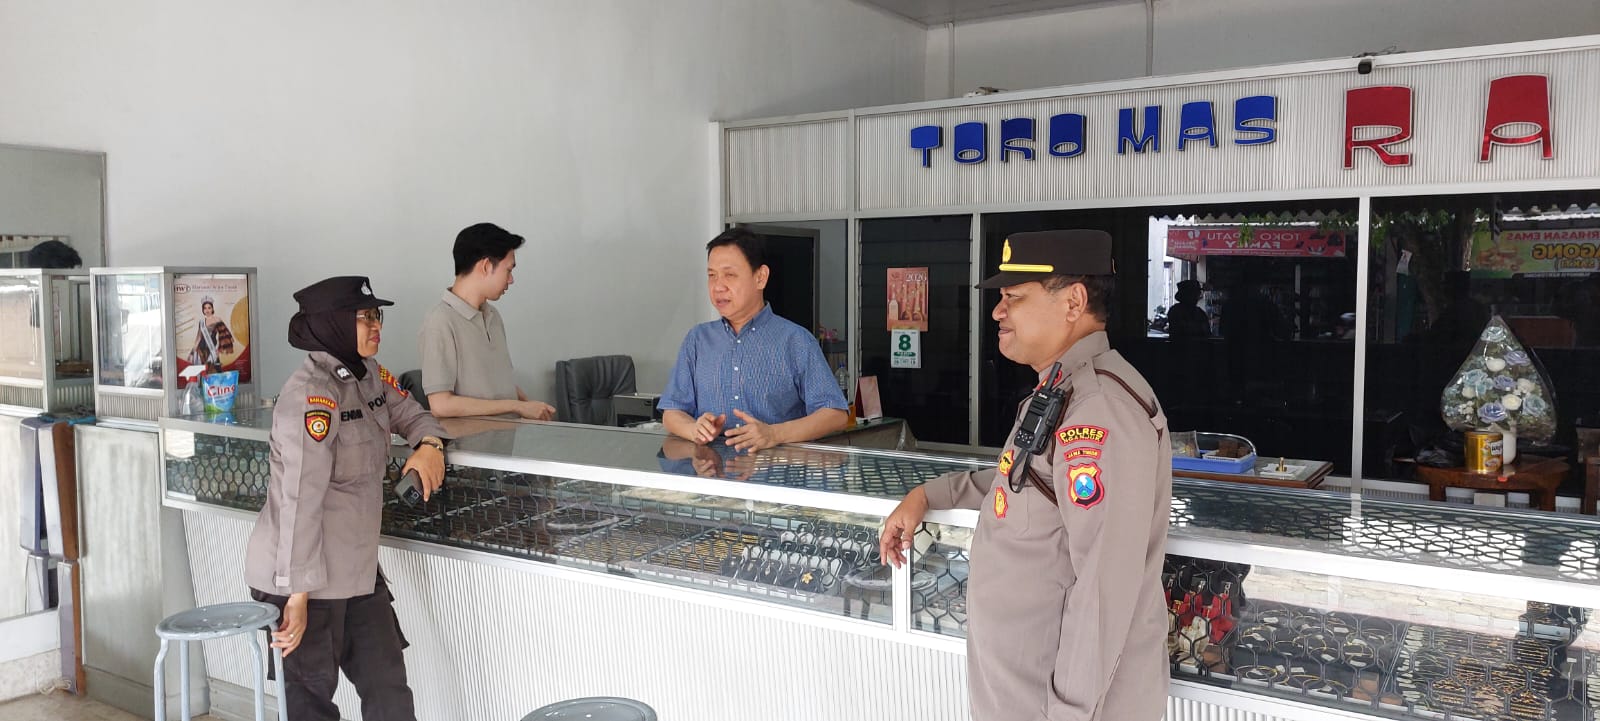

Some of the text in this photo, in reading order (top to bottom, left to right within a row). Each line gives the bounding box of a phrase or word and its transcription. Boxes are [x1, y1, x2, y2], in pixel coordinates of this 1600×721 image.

[911, 112, 1087, 168] TOKO
[1118, 95, 1278, 155] MAS
[899, 334, 911, 351] 8
[1059, 427, 1104, 441] POLRES
[1063, 434, 1101, 444] NGANJUK
